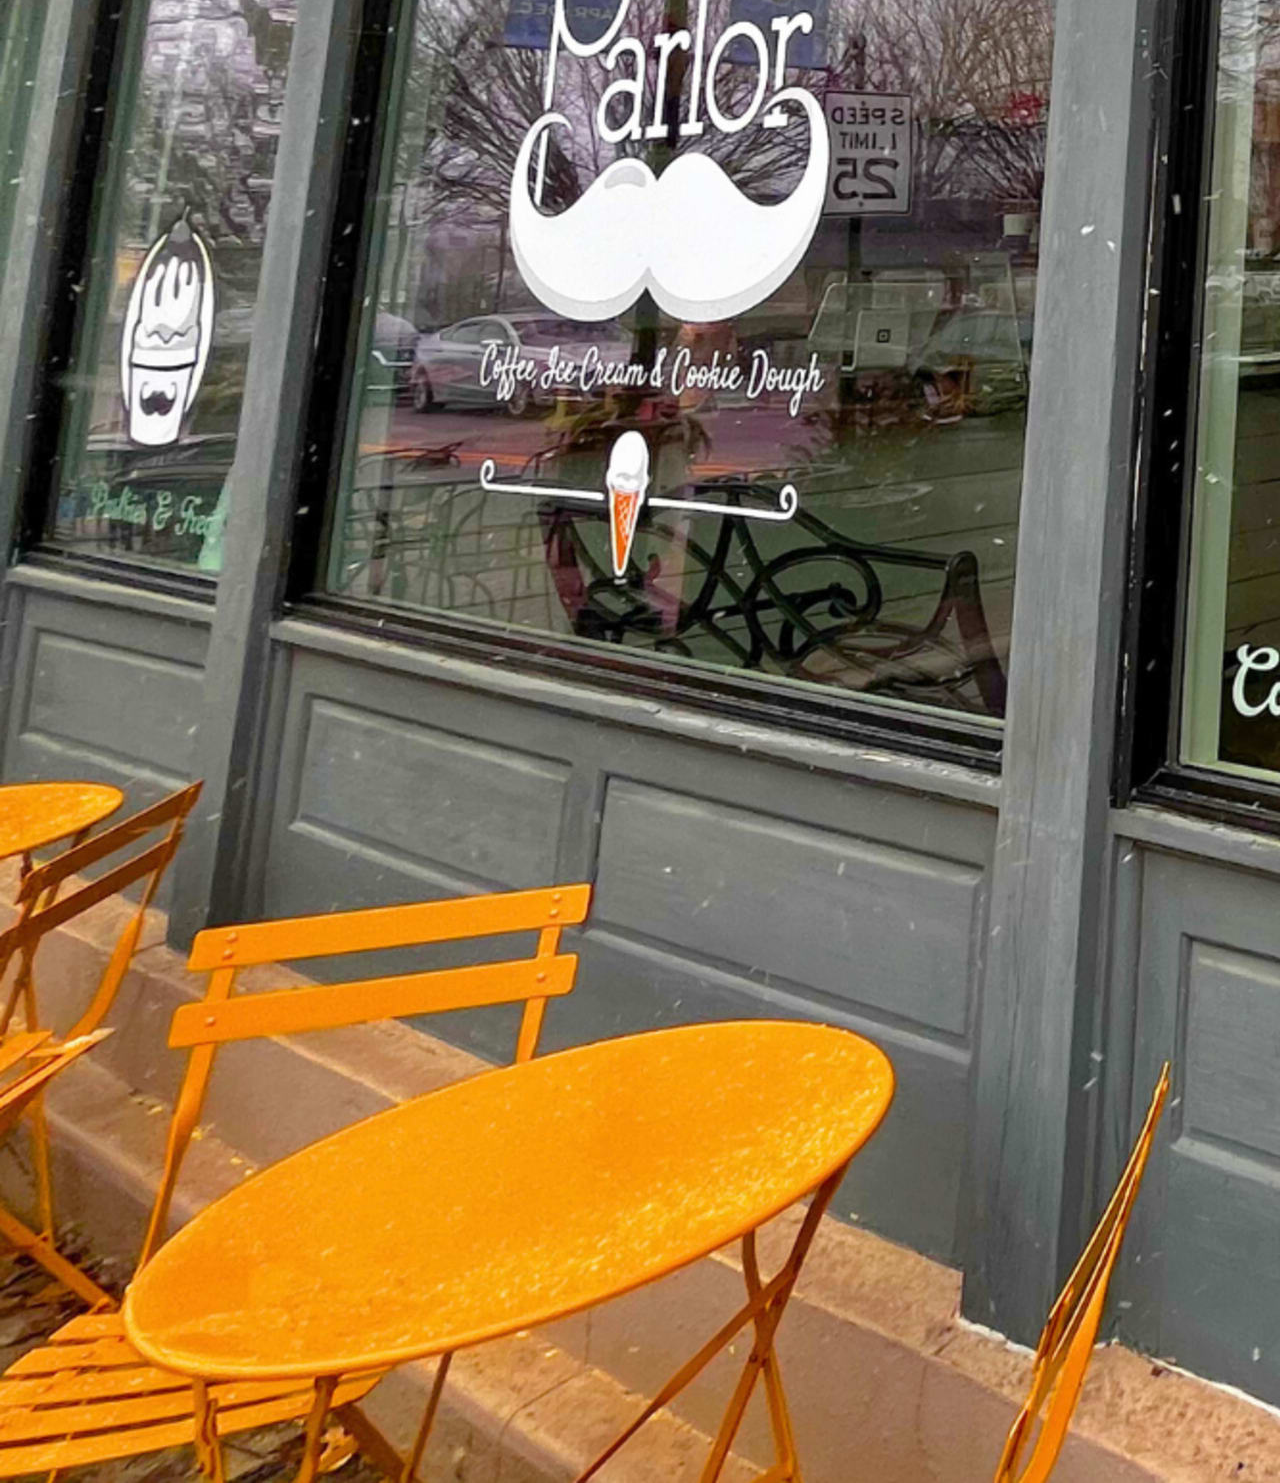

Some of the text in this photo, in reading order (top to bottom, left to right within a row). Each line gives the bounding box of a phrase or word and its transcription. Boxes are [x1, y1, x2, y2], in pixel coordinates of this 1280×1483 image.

[540, 345, 578, 390] Ice
[579, 345, 648, 392] Cream
[650, 347, 668, 388] &
[671, 345, 743, 396] Cookie
[746, 349, 825, 417] Dough
